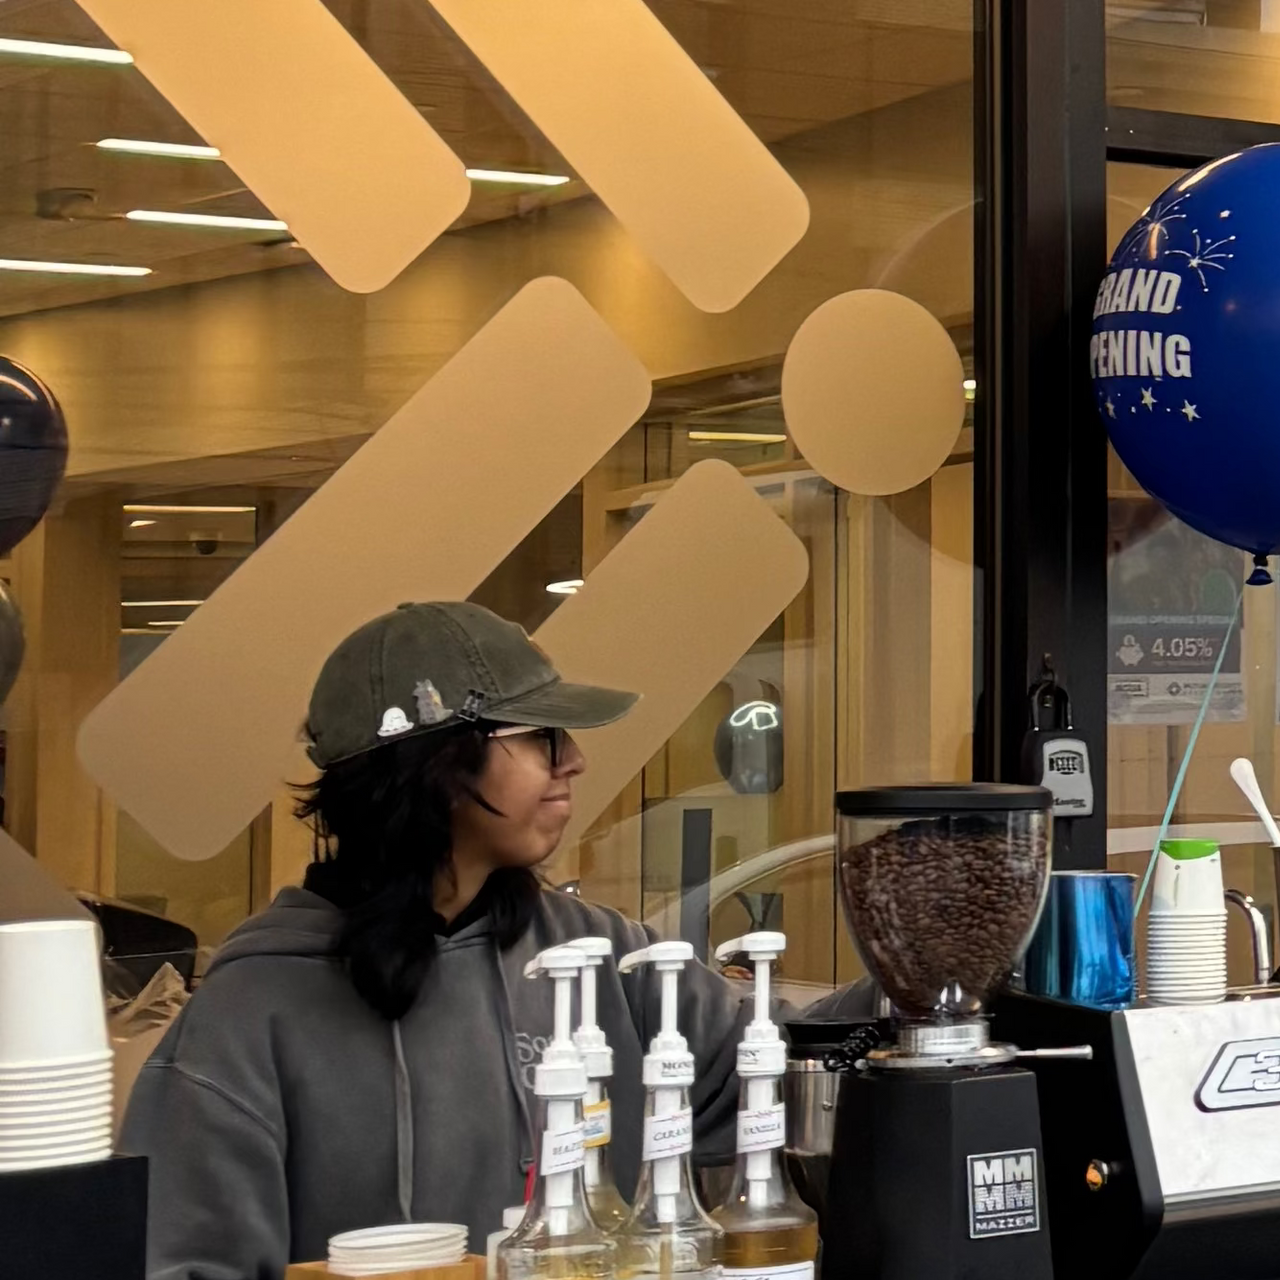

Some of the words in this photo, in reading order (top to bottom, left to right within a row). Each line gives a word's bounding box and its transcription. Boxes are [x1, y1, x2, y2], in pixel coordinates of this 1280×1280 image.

[1089, 329, 1192, 379] PENING
[1151, 637, 1213, 658] 4.05%
[975, 1215, 1035, 1231] MAZZER
